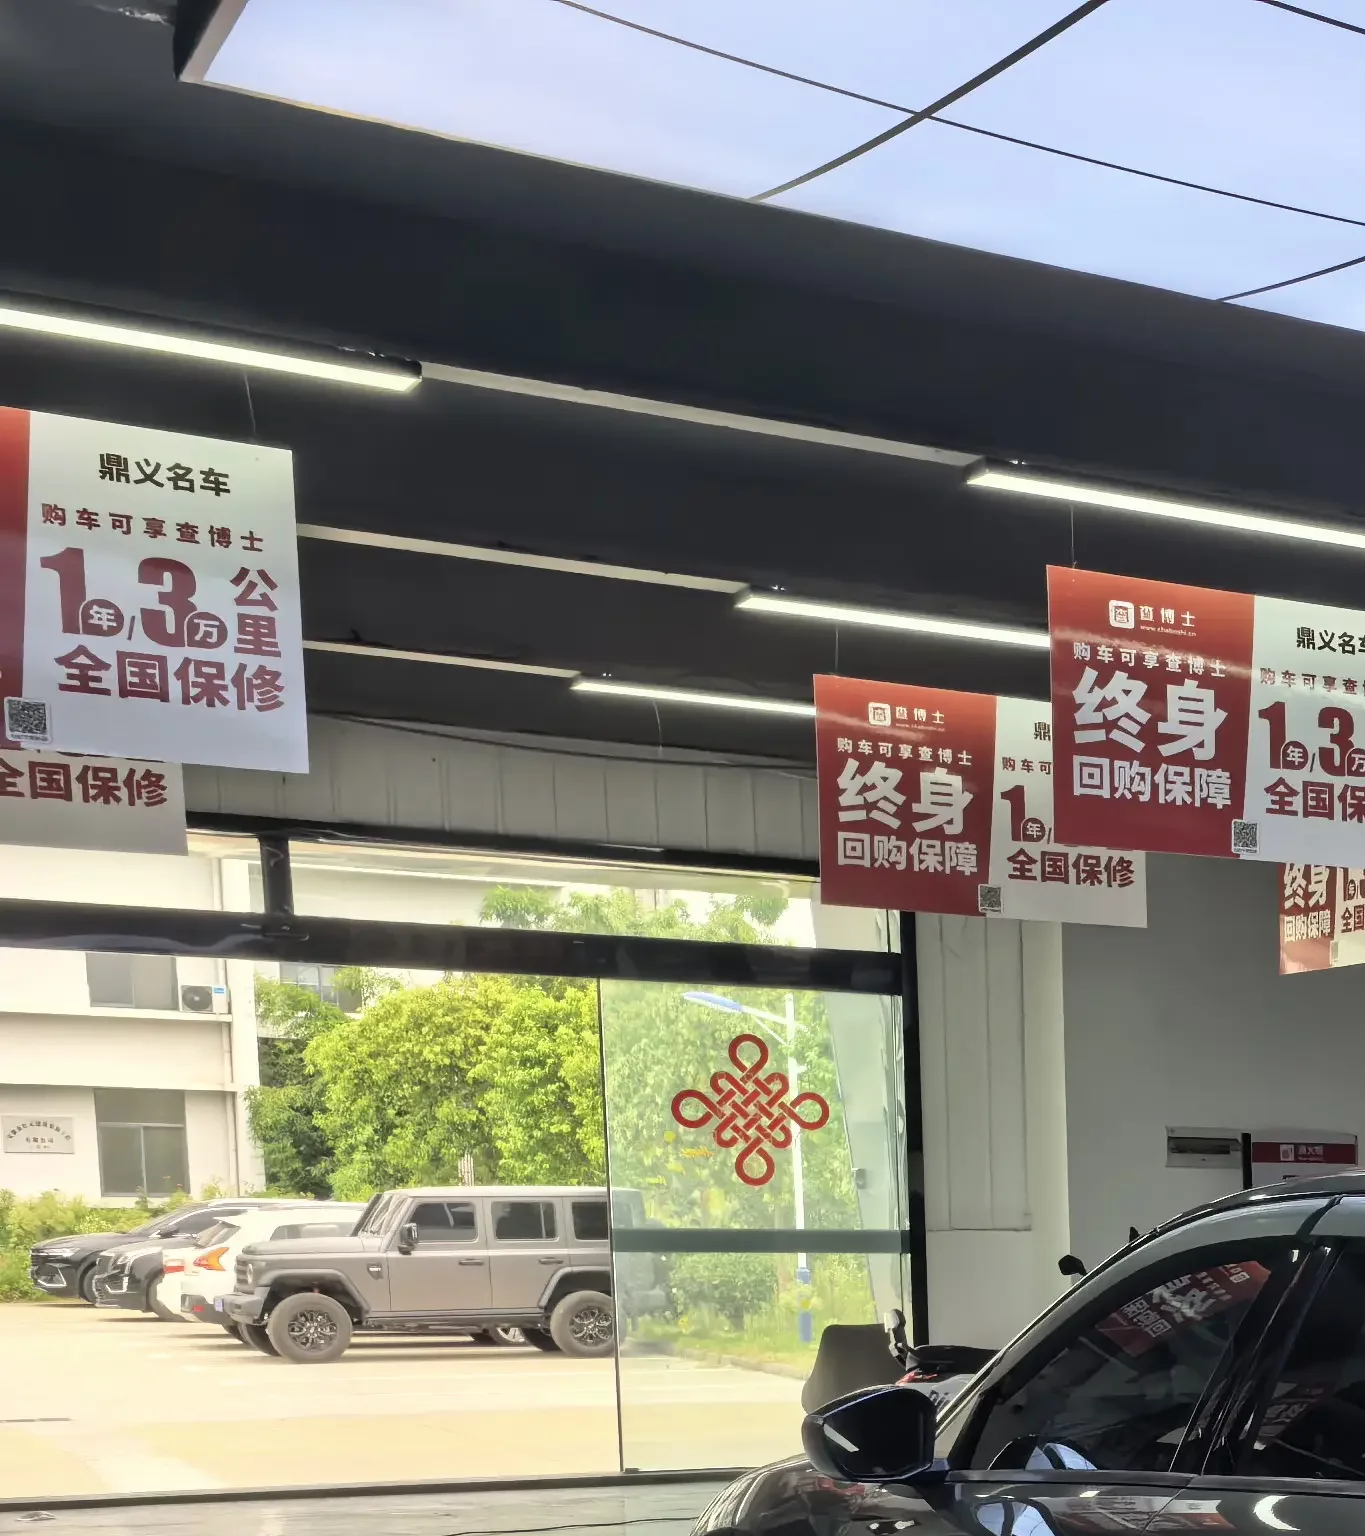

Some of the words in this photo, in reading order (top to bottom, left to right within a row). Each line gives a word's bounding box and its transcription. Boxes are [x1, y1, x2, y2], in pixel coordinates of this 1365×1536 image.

[99, 451, 231, 497] 鼎义名车
[41, 503, 264, 552] 购车可享查博士
[1139, 605, 1196, 628] 查博士
[55, 645, 285, 712] 全国保修
[1073, 641, 1227, 678] 购车可享查博士
[1072, 666, 1228, 760] 终身
[837, 737, 972, 766] 购车可享查博士
[836, 757, 974, 835] 终身
[1072, 755, 1232, 810] 回购保障
[837, 831, 978, 876] 回购保障
[1007, 848, 1135, 888] 全国保修
[1283, 863, 1330, 910] 终身
[1284, 909, 1331, 943] 回购保障
